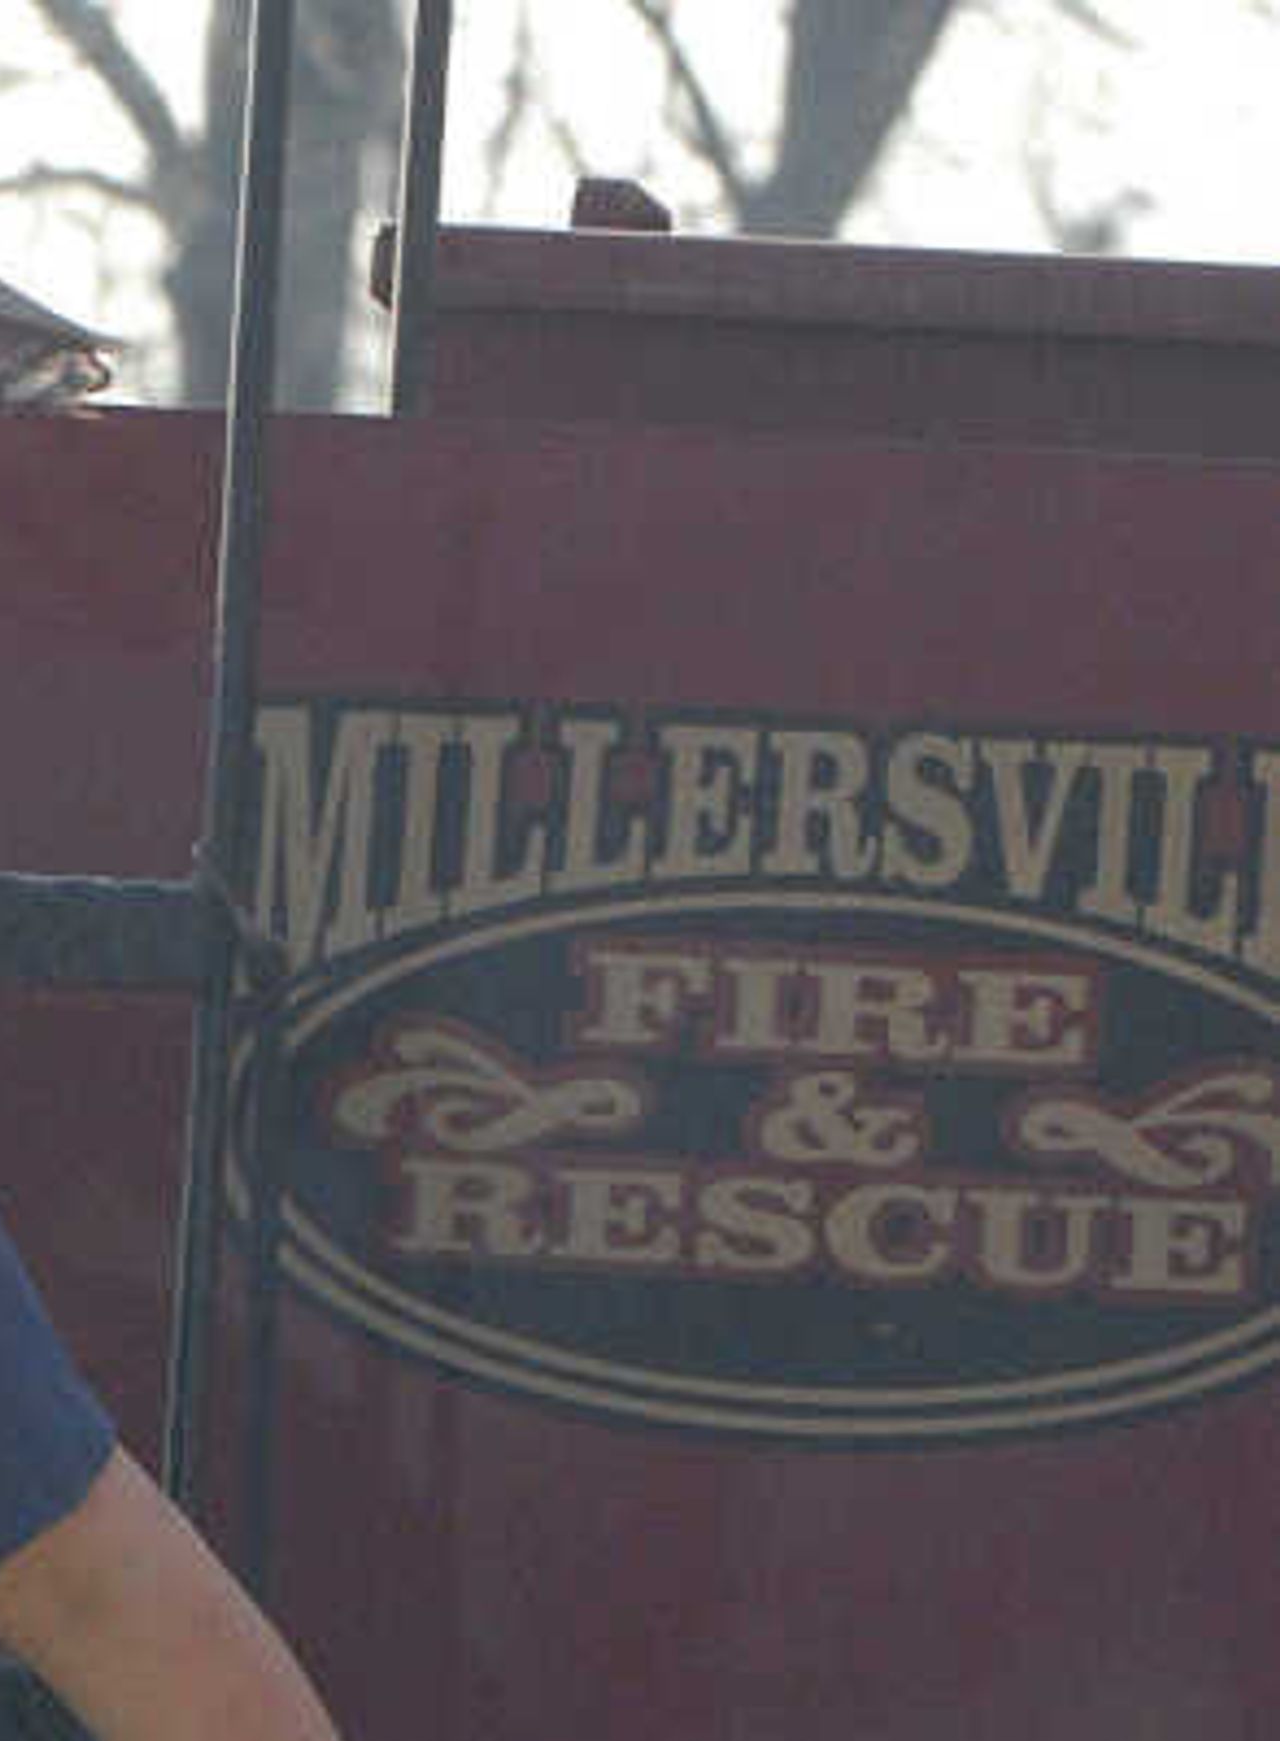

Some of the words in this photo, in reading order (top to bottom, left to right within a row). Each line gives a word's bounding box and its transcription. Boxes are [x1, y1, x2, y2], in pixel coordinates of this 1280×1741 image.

[574, 947, 1090, 1068] FIRE
[760, 1070, 926, 1169] &
[394, 1157, 1250, 1295] RESCUE
